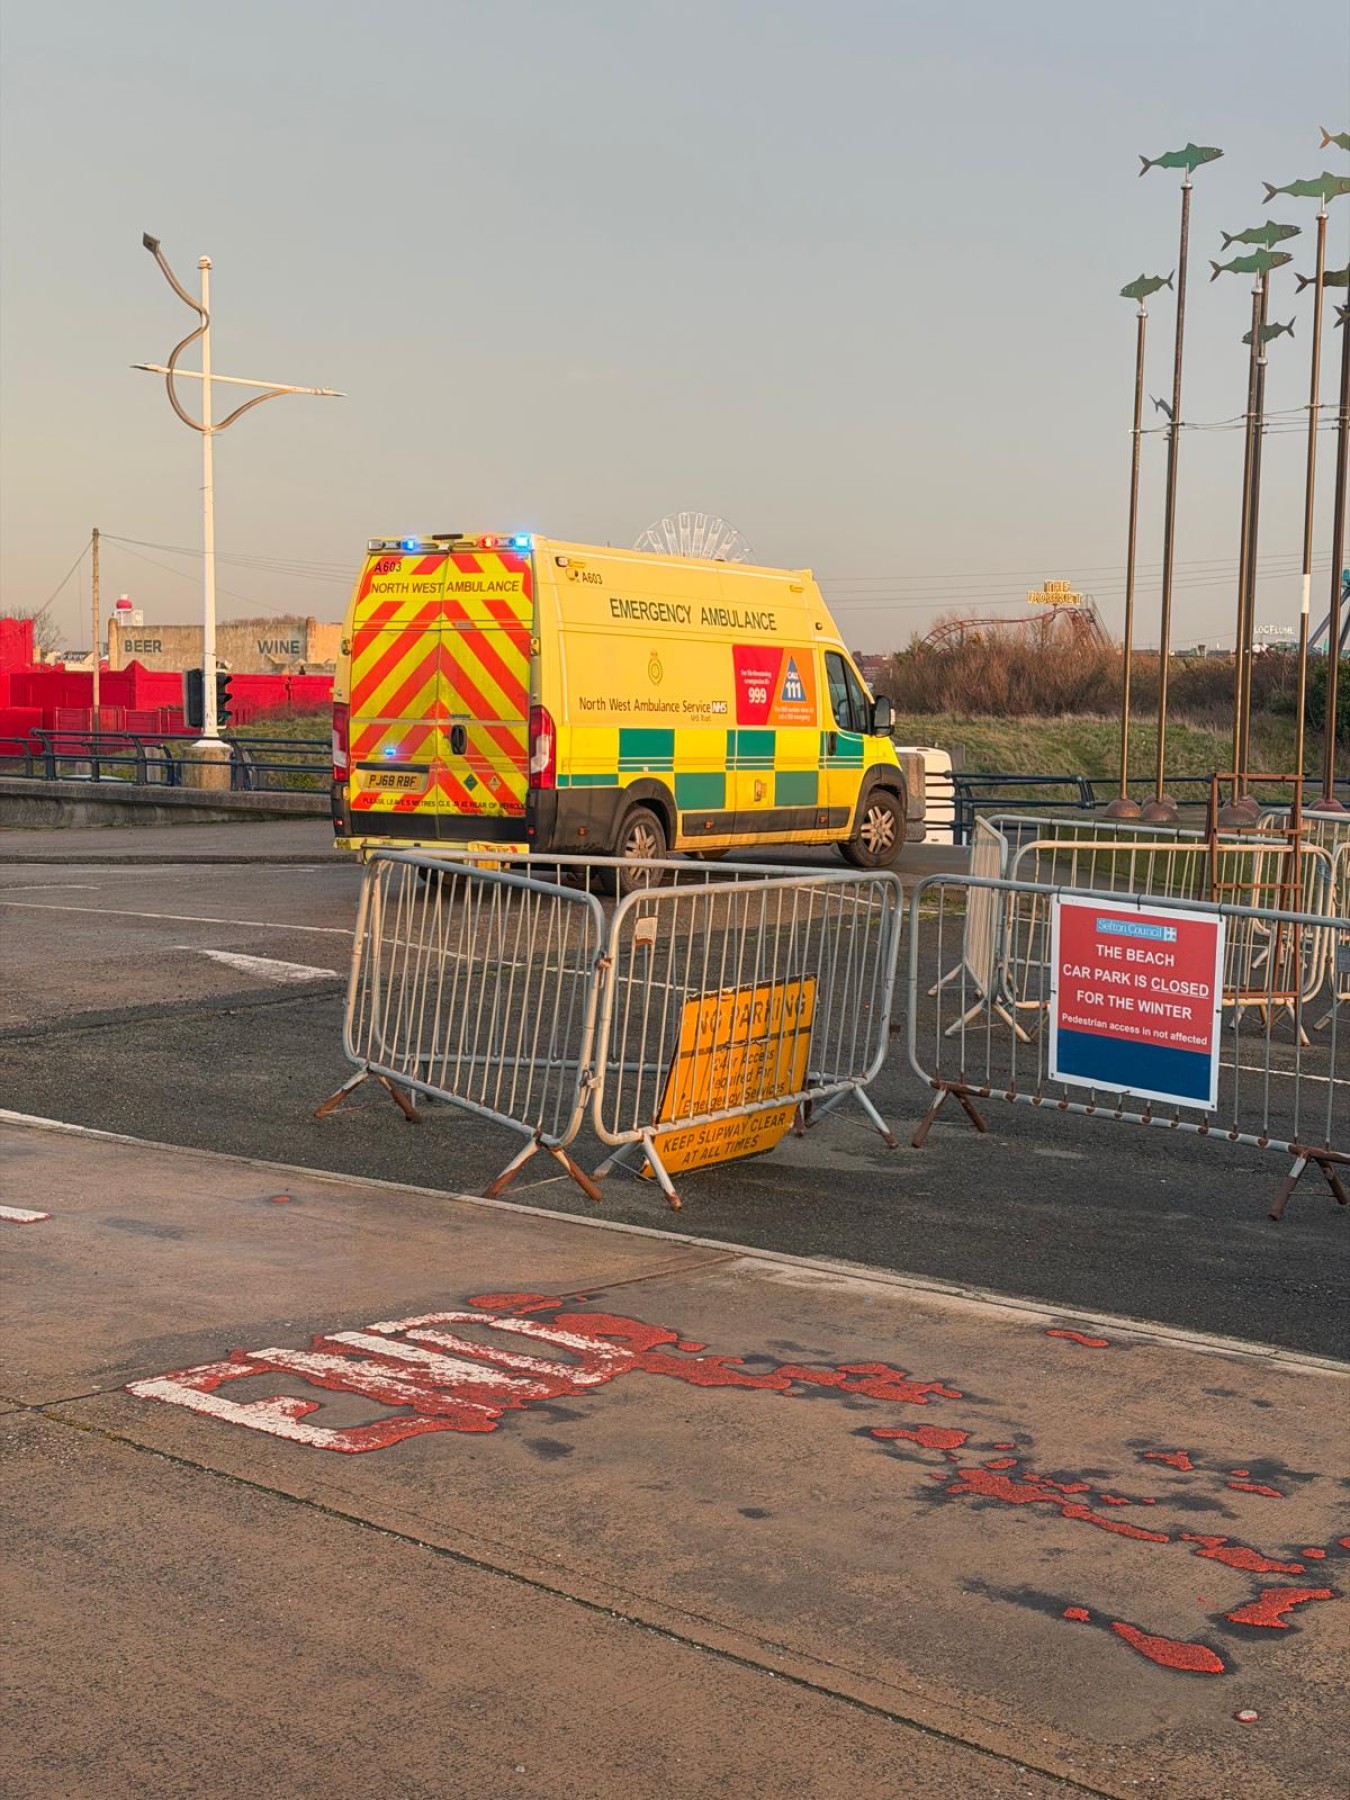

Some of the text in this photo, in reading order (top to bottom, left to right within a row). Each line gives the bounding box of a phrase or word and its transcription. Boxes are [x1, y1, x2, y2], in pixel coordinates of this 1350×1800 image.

[374, 561, 402, 573] A603
[371, 580, 520, 594] NORTH WEST AMBULANCE
[582, 572, 603, 585] A603
[1044, 579, 1071, 592] THE
[1028, 591, 1083, 605] ROCKET
[610, 598, 778, 631] EMERGENCY AMBULANCE
[124, 639, 162, 653] BEER
[257, 640, 300, 654] WINE
[748, 687, 767, 704] 999
[785, 682, 802, 699] 111
[579, 697, 728, 714] North West Ambulance Service NHS
[368, 775, 417, 786] PJ68 RBF
[1128, 923, 1162, 938] Council
[1096, 944, 1175, 967] THE BEACH
[1062, 964, 1210, 997] CAR PARK IS CLOSED
[1077, 990, 1193, 1020] FOR THE WINTER
[1061, 1013, 1208, 1046] Pedestrian access in not affected
[663, 1112, 786, 1153] KEEP SLIPWAY CLEAR
[682, 1134, 760, 1164] AT ALL TIMES
